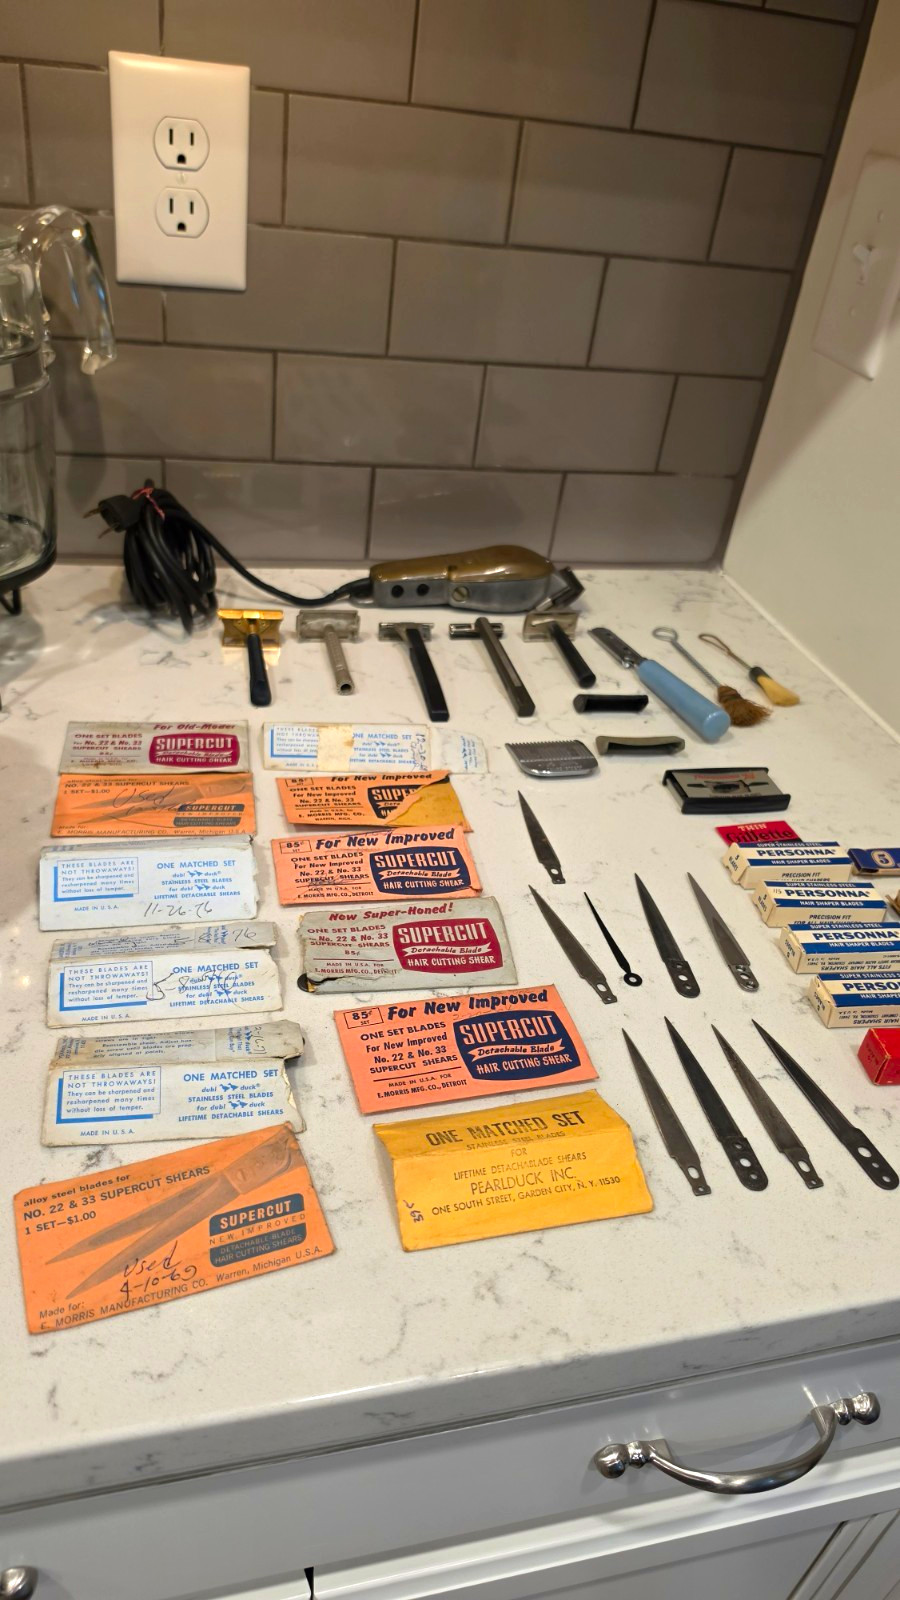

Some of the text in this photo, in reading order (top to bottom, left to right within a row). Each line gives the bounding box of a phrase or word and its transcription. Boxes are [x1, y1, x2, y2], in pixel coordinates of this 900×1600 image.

[153, 723, 173, 731] For
[156, 737, 233, 750] SUPERCUT
[354, 774, 377, 782] New
[381, 773, 432, 782] Improved
[737, 823, 767, 831] THIN
[315, 827, 455, 850] For New Improved
[330, 851, 364, 861] BLADES
[374, 850, 457, 869] SUPERCUT
[877, 854, 890, 865] 5
[156, 859, 236, 870] ONE MATCHED SET
[328, 902, 454, 921] Now Super-Honed!
[350, 924, 386, 933] BLADES
[397, 921, 488, 945] SUPERCUT
[172, 961, 259, 975] ONE MATCHED SET
[407, 955, 496, 967] HAIR CUTTING SHEAR
[842, 981, 900, 992] PERSO
[387, 989, 548, 1021] For New Improved
[360, 1021, 447, 1041] ONE SET BLADES
[459, 1015, 557, 1045] SUPERCUT
[366, 1031, 448, 1053] For New Improved
[477, 1044, 555, 1056] Detachable Blade
[374, 1045, 447, 1064] No. 22 & No. 33
[370, 1054, 458, 1074] SUPERCUT SHEARS
[476, 1053, 572, 1075] HAIR CUTTING SHEAR
[101, 1071, 135, 1079] BLADES
[183, 1069, 279, 1082] ONE MATCHED SET
[384, 1087, 410, 1098] MORRIS
[441, 1079, 467, 1089] DETROIT
[388, 1080, 407, 1088] MADE
[108, 1088, 141, 1098] sharpened
[188, 1091, 274, 1103] STAINLESS STEEL BLADES
[66, 1097, 110, 1106] resharpened
[66, 1106, 91, 1114] without
[178, 1108, 284, 1123] LIFETIME DETACHABLE SHEARS
[426, 1110, 586, 1146] ONE MATCHED SET
[511, 1134, 533, 1144] STEEL
[537, 1130, 565, 1140] BLADES
[511, 1148, 527, 1157] FOR
[453, 1167, 487, 1181] LIFETIME
[557, 1151, 587, 1163] SHEARS
[470, 1166, 577, 1195] PEARLDUCK INC.
[23, 1174, 130, 1207] alloy steel blades for
[23, 1165, 210, 1221] NO. 22 & 33 SUPERCUT SHEARS
[431, 1205, 451, 1216] ONE
[454, 1199, 483, 1211] SOUTH
[486, 1193, 516, 1206] STREET,
[518, 1187, 551, 1200] GARDEN
[554, 1183, 576, 1194] CITY,
[599, 1175, 621, 1186] 11530
[219, 1199, 292, 1230] SUPERCUT
[25, 1226, 31, 1235] 1
[209, 1213, 306, 1245] NEW IMPROVED
[214, 1234, 303, 1264] HAIR CUTTING SHEARS
[55, 1309, 95, 1328] MORRIS
[100, 1283, 188, 1315] MANUFACTURING
[192, 1278, 208, 1289] CO.
[216, 1268, 250, 1283] Warren,
[252, 1255, 291, 1273] Michigan
[39, 1301, 85, 1319] Made for:
